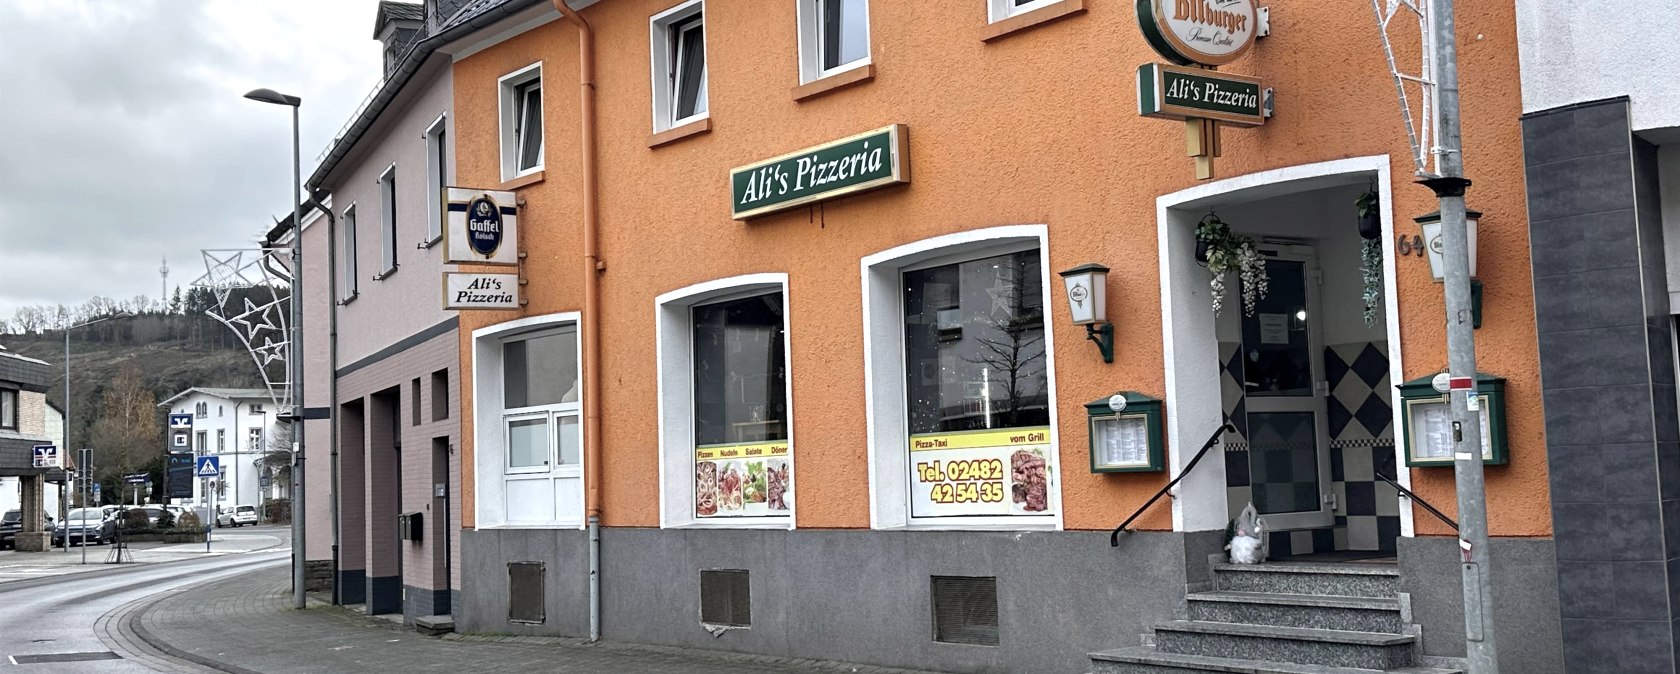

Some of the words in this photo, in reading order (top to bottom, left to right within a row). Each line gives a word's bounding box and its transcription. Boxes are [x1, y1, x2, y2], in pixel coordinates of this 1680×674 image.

[1203, 82, 1257, 109] Pizzeria
[793, 140, 883, 192] Pizzeria
[470, 218, 499, 233] Gaffel
[1398, 234, 1424, 257] 64
[455, 290, 513, 304] Pizzeria
[915, 438, 948, 449] Pizza-Taxi
[1028, 432, 1044, 442] Grill
[697, 450, 714, 458] Pizzen
[720, 449, 739, 457] Nudeln
[745, 447, 763, 455] Salate
[771, 445, 788, 454] Döner
[917, 460, 946, 483] Tel.
[947, 458, 1004, 482] 02482
[930, 483, 955, 504] 42
[955, 482, 979, 503] 54
[980, 481, 1005, 503] 35
